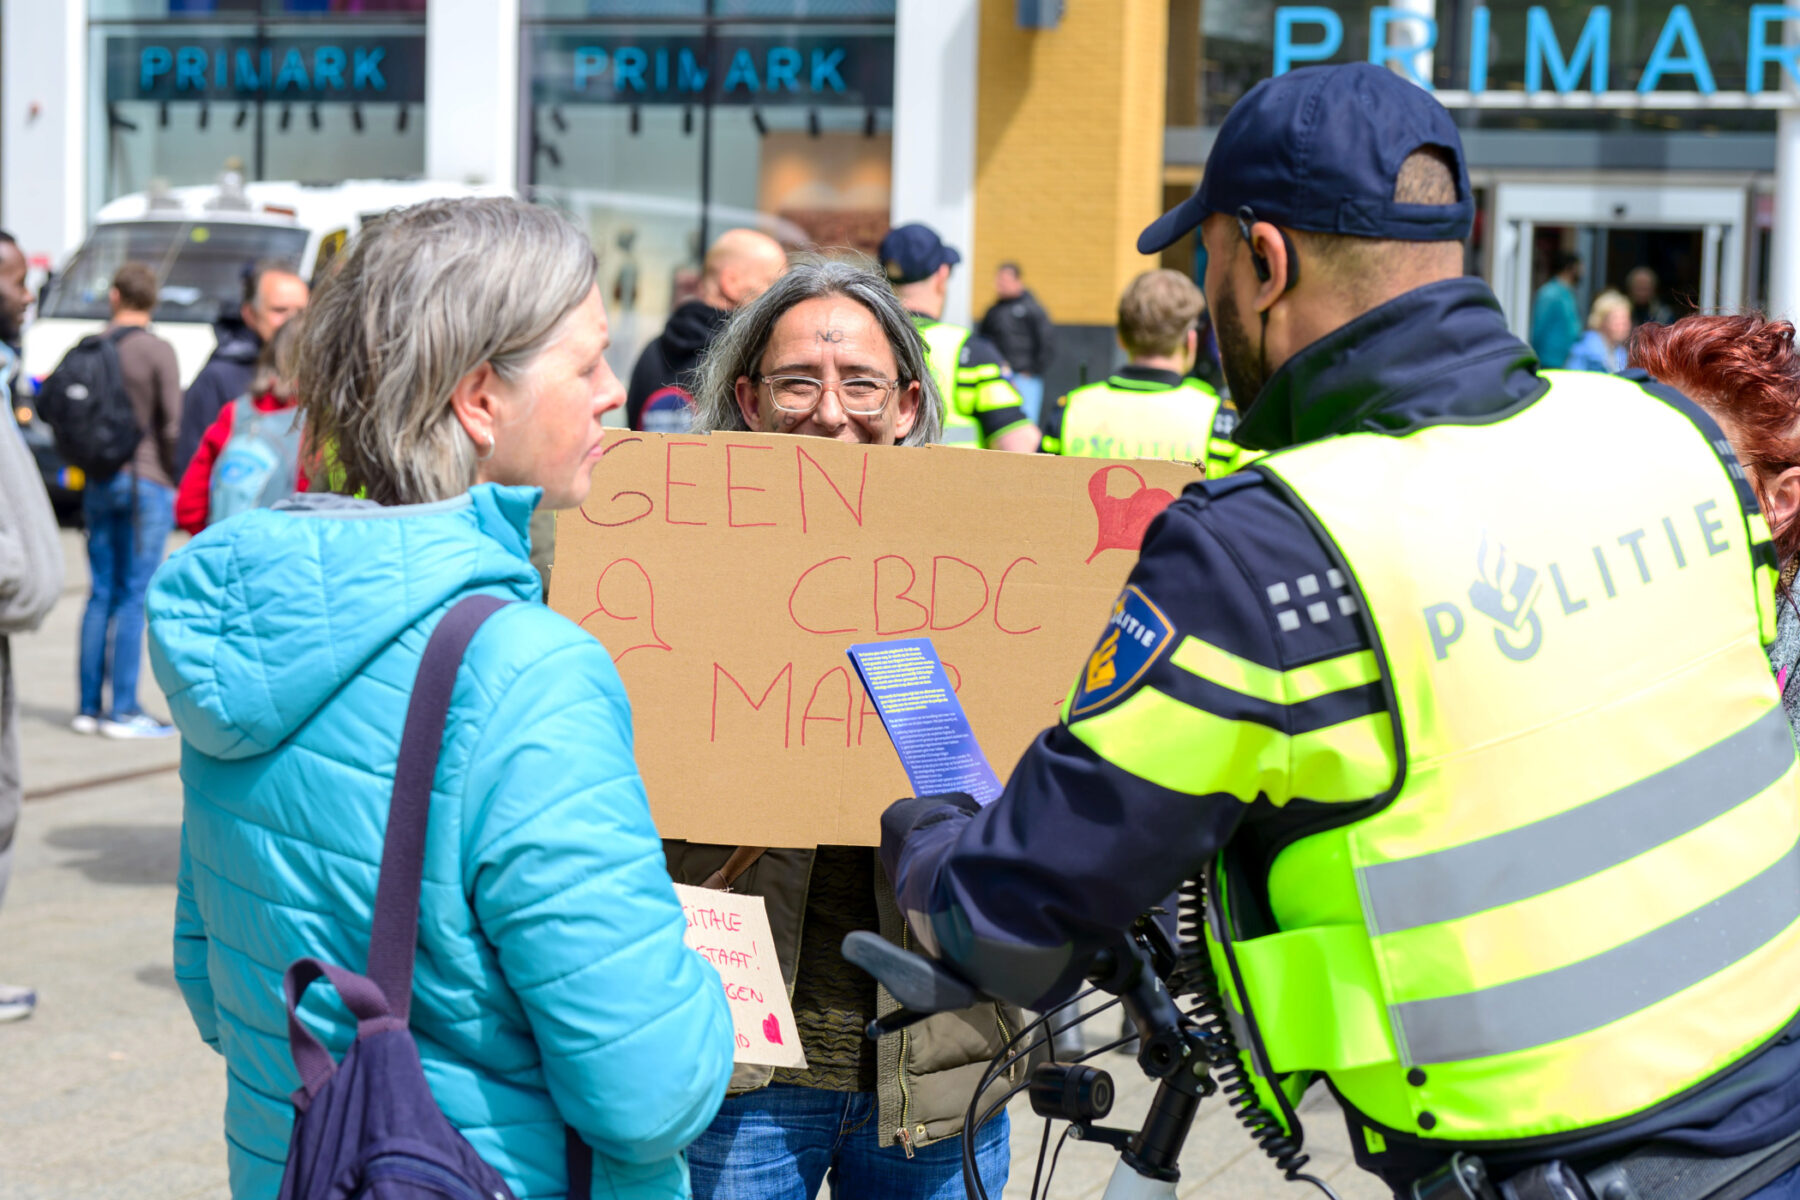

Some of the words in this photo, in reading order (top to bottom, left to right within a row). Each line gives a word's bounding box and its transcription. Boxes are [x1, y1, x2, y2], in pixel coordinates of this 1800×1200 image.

[139, 45, 389, 92] PRIMARK
[572, 45, 848, 93] PRIMARK
[1274, 4, 1800, 94] PRIMAR
[815, 329, 844, 345] NO
[579, 437, 868, 533] GEEN
[788, 554, 1041, 635] CBDC
[1111, 610, 1156, 648] LITIE
[723, 983, 764, 1003] GEN
